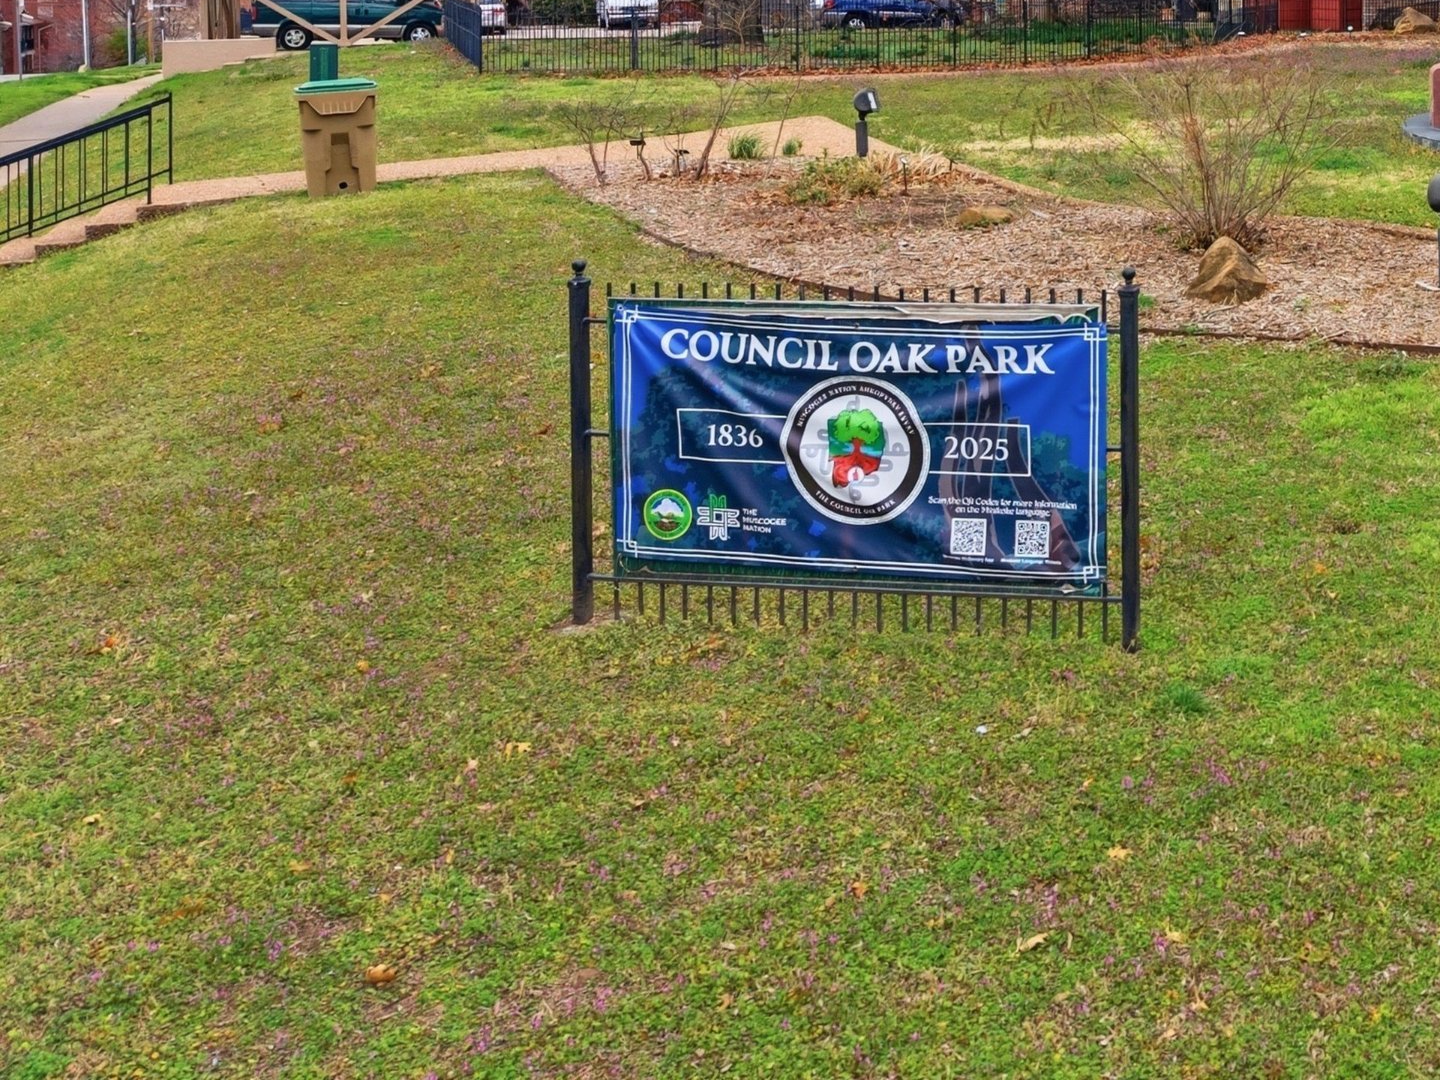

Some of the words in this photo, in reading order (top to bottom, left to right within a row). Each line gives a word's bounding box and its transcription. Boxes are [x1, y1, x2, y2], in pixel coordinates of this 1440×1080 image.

[660, 328, 839, 371] COUNCIL
[849, 341, 938, 374] OAK
[945, 343, 1056, 374] PARK
[707, 423, 764, 448] 1836
[944, 436, 1009, 461] 2025
[928, 495, 947, 505] Scan
[947, 496, 961, 506] the
[742, 508, 758, 517] THE
[955, 506, 966, 514] on
[967, 506, 980, 514] the
[742, 516, 787, 526] MUSCOGEE
[743, 524, 772, 534] NATION
